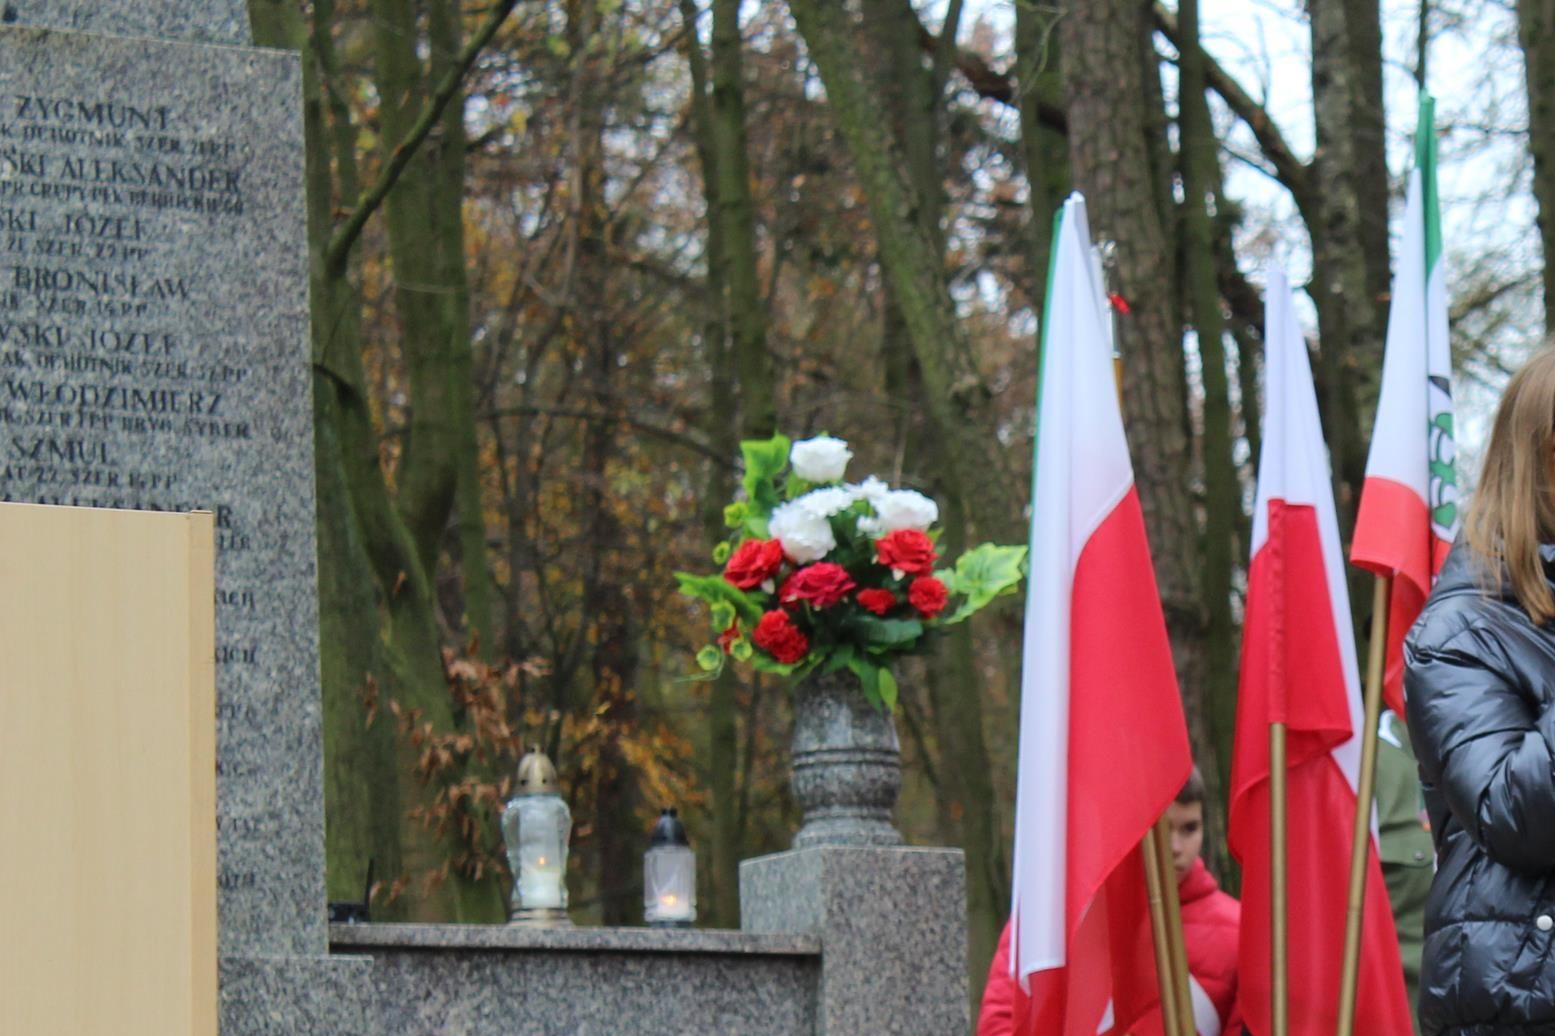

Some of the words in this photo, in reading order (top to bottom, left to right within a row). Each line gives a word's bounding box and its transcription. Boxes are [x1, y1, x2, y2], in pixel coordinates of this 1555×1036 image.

[16, 94, 168, 130] ZYGMUNT
[61, 155, 241, 194] ALEKSANDER
[14, 265, 189, 301] BRONISŁAW
[7, 381, 223, 417] WŁODZIMIERZ
[11, 436, 118, 467] SZMUL
